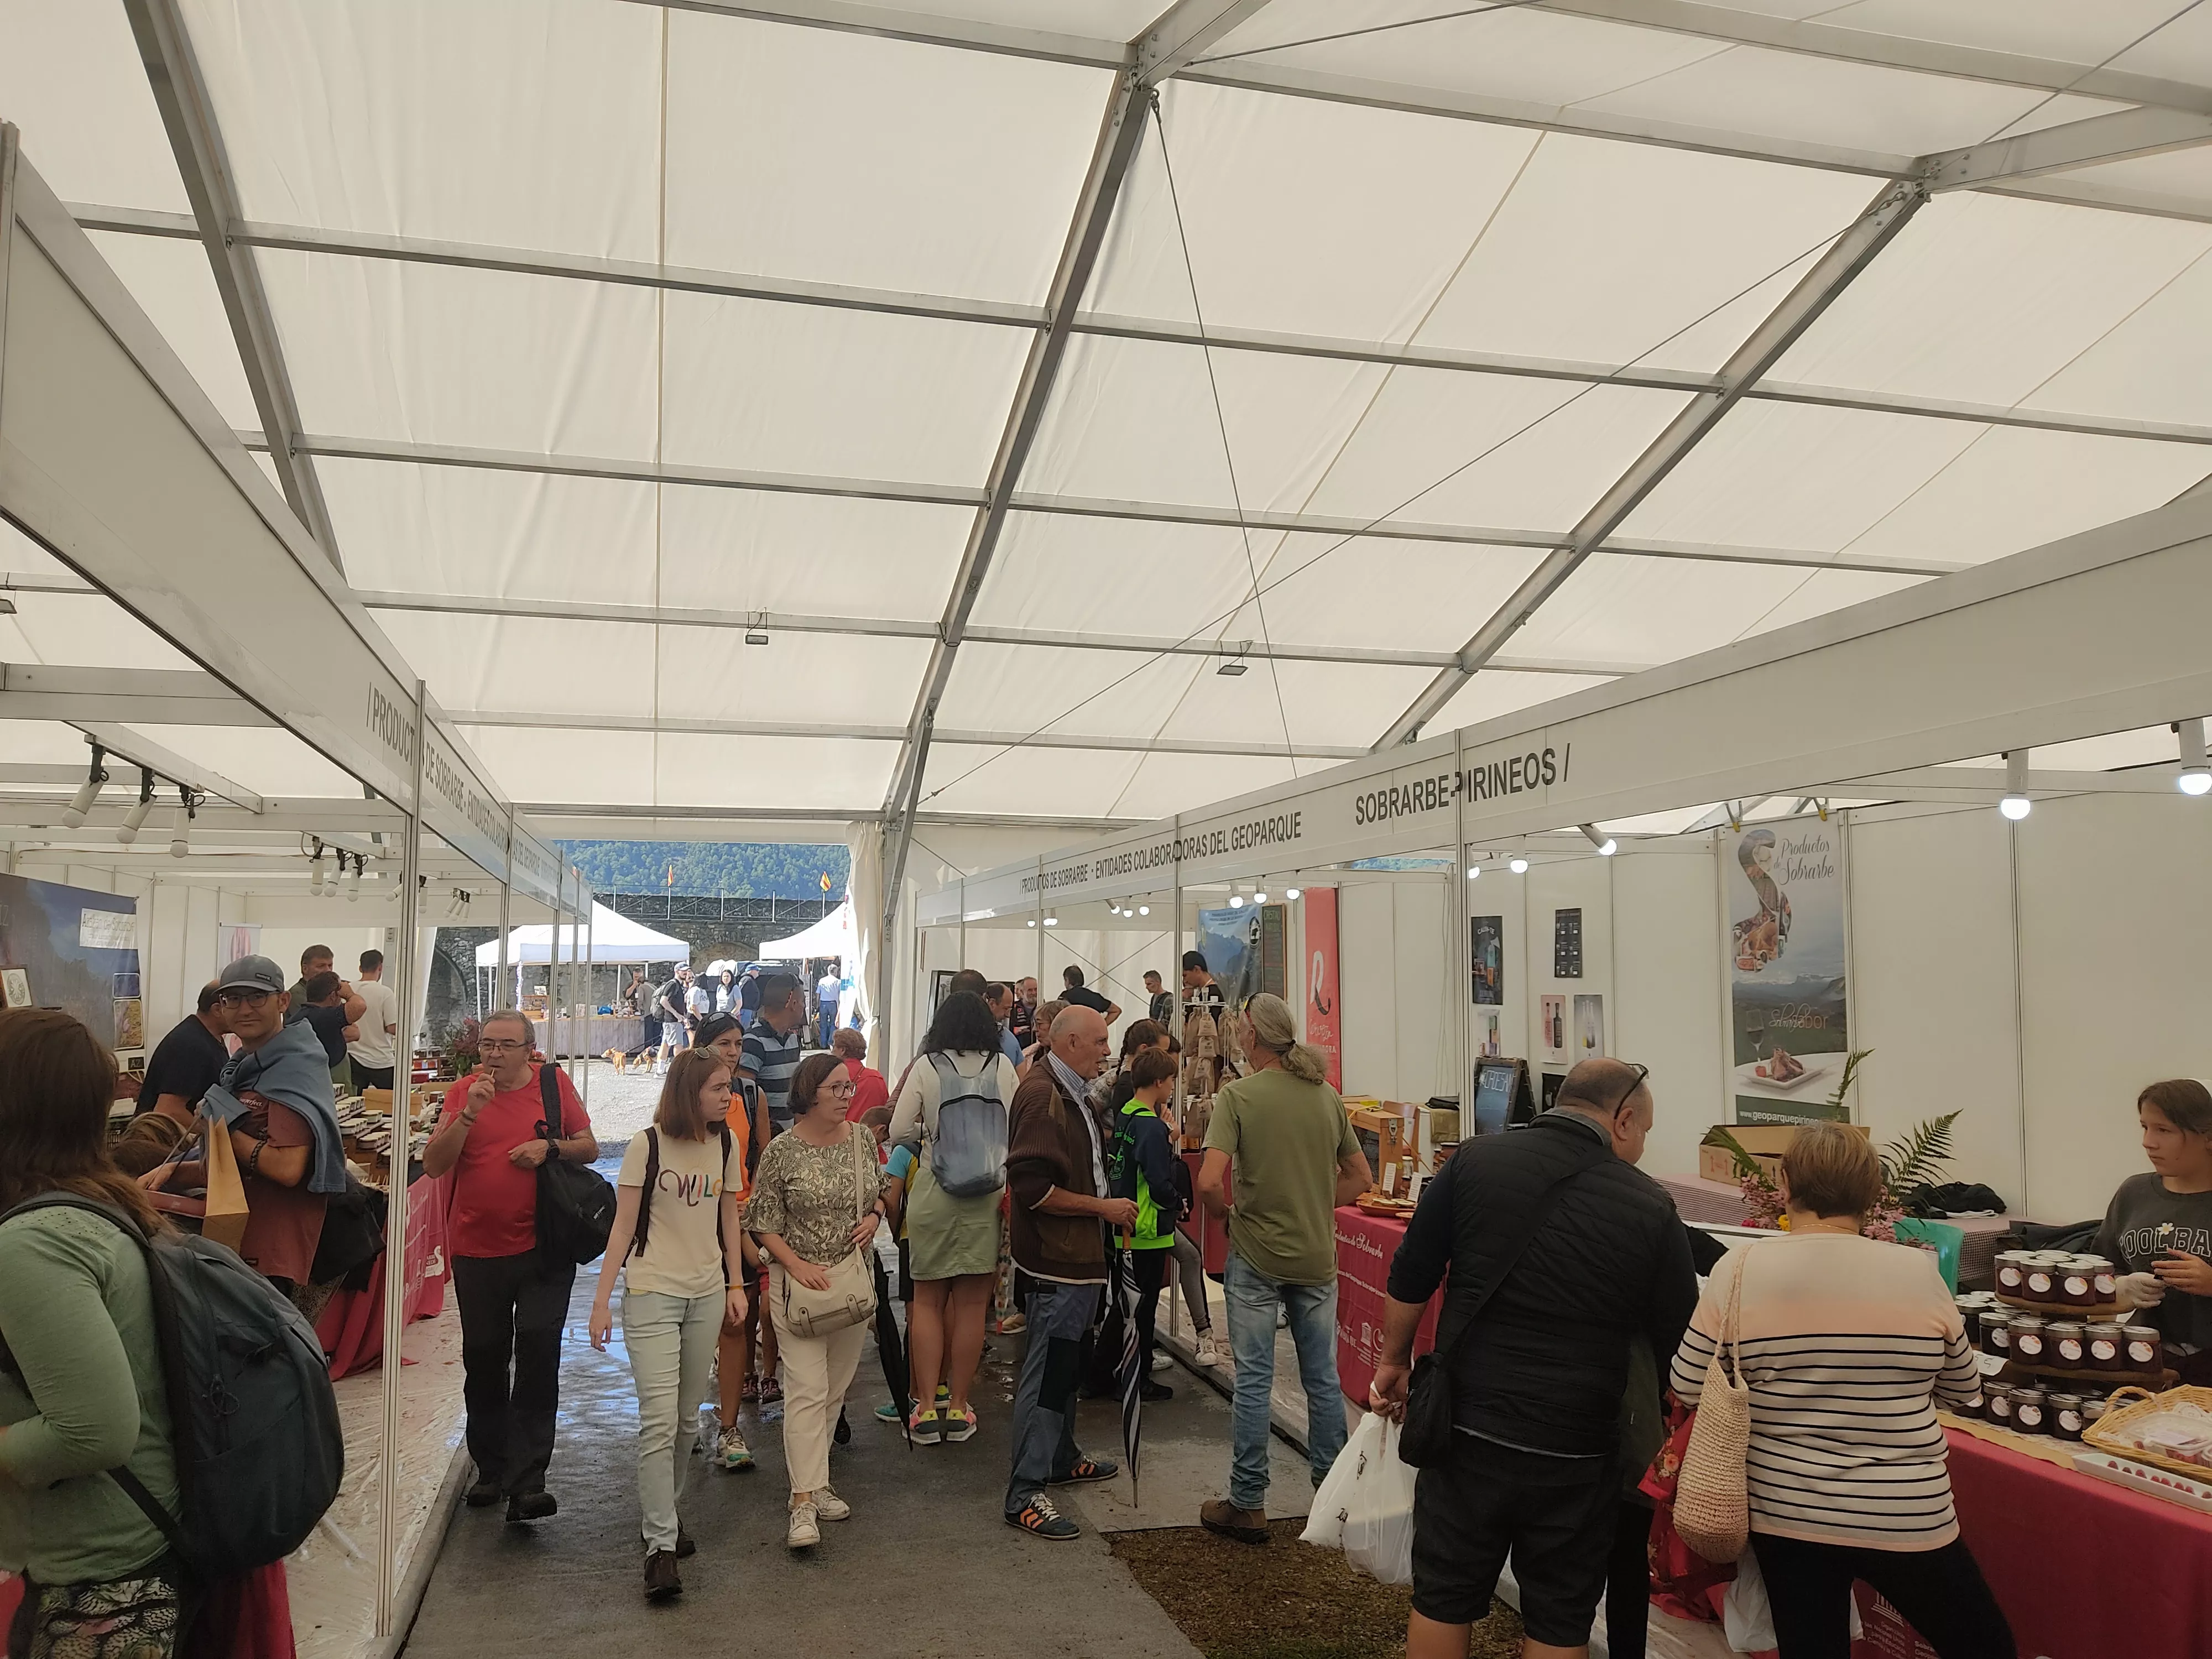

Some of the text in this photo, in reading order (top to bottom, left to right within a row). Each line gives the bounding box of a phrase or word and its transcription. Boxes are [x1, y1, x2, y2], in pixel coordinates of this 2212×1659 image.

[425, 740, 435, 785] DE
[435, 752, 464, 813] SOBRARBE
[467, 789, 489, 837] ENTIDADES
[1050, 871, 1057, 889] DE
[1058, 863, 1088, 888] SOBRARBE
[1095, 852, 1133, 879] ENTIDADES
[1134, 834, 1208, 870] COLABORADORAS
[1210, 830, 1229, 855] DEL
[1232, 811, 1302, 851] GEOPARQUE
[1773, 854, 1835, 886] de Sobrarbe
[1780, 833, 1830, 860] Productos
